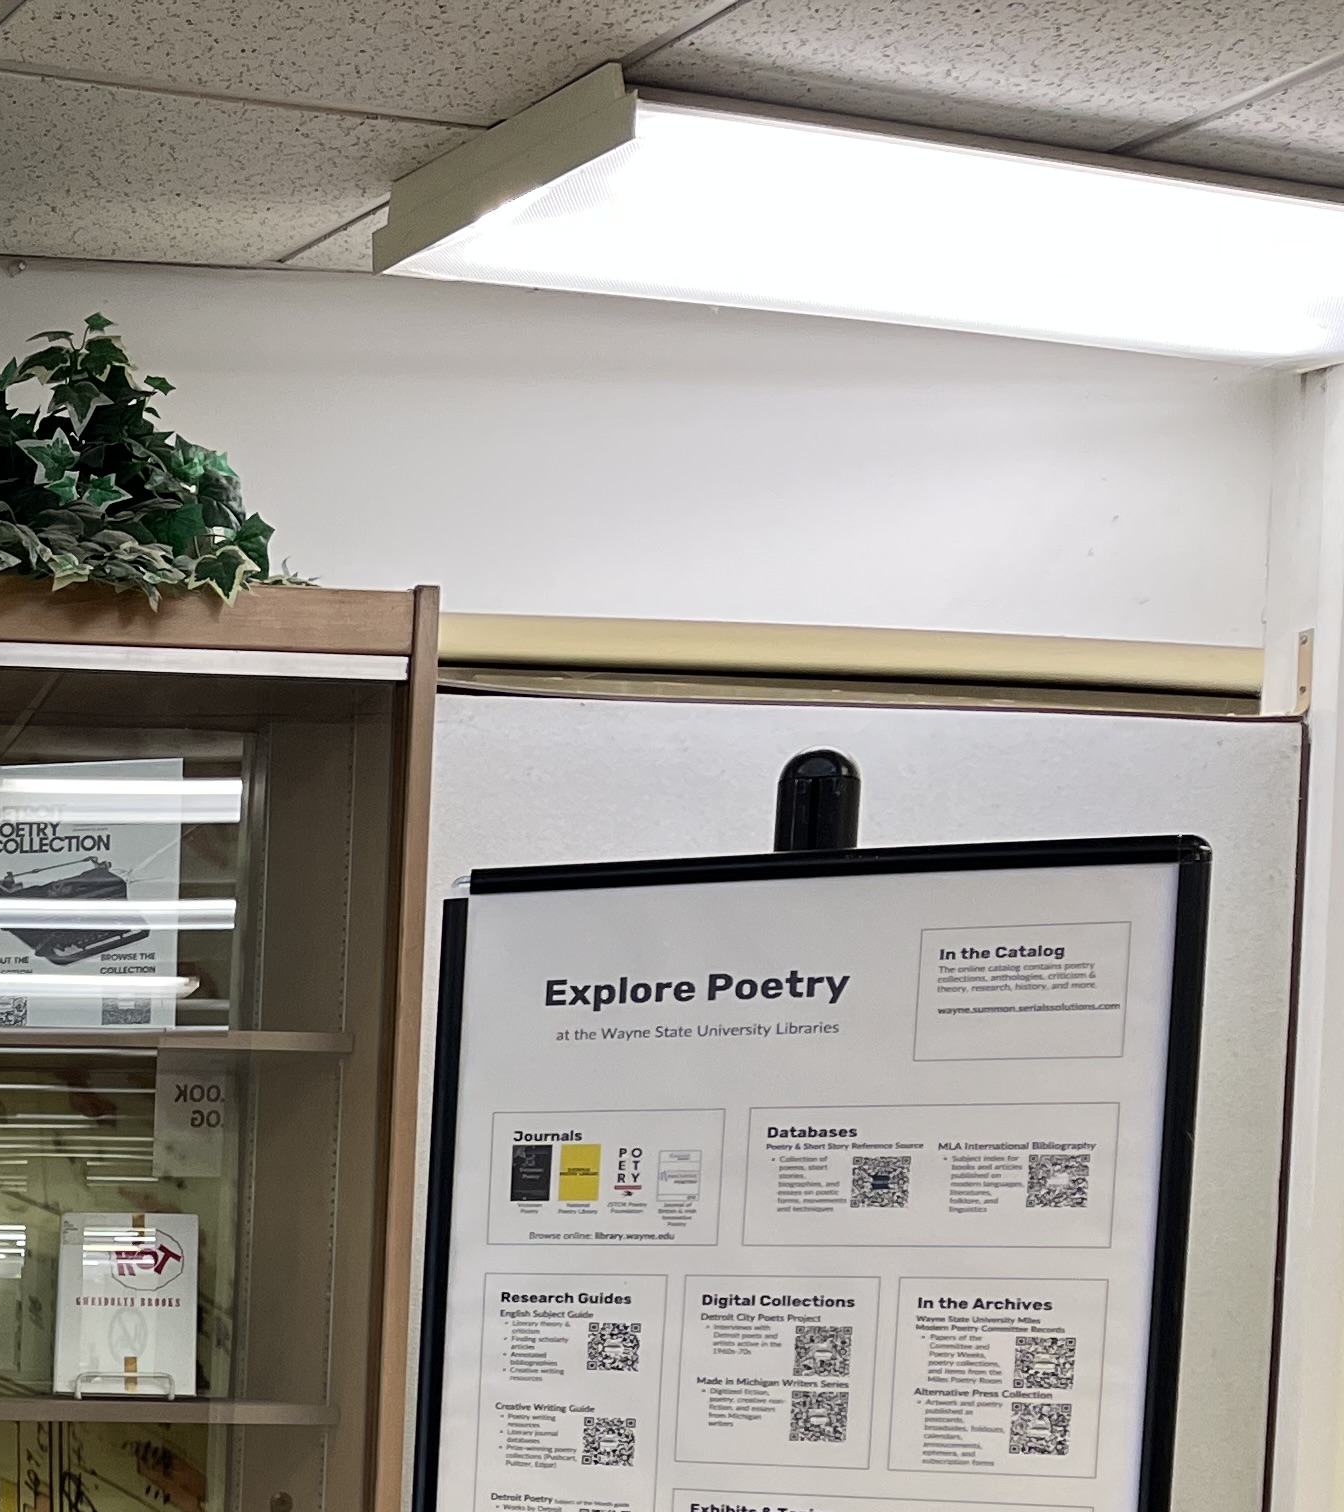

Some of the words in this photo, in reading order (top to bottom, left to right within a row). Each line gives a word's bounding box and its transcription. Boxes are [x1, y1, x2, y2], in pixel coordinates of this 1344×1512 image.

[100, 953, 139, 962] BROWSE
[140, 952, 156, 961] THE
[941, 949, 956, 960] In
[961, 947, 991, 960] the
[995, 945, 1065, 959] Catalog
[12, 956, 30, 965] THE
[99, 965, 156, 975] COLLECTION
[545, 977, 696, 1012] Explore
[707, 970, 850, 1004] Poetry
[556, 1030, 570, 1041] at
[575, 1029, 597, 1041] the
[601, 1027, 651, 1040] Wayne
[655, 1025, 693, 1038] State
[697, 1024, 771, 1037] University
[776, 1022, 840, 1035] Libraries
[513, 1130, 582, 1142] Journals
[767, 1126, 858, 1138] Databases
[939, 1143, 963, 1151] MLA
[964, 1143, 1030, 1151] International
[1032, 1142, 1097, 1151] Bibliography
[140, 1298, 181, 1307] BROOKS
[502, 1292, 574, 1304] Research
[578, 1293, 632, 1305] Guides
[703, 1294, 756, 1308] Digital
[760, 1295, 855, 1308] Collections
[919, 1297, 934, 1309] In
[939, 1298, 968, 1309] the
[973, 1298, 1053, 1311] Archives
[501, 1310, 531, 1319] English
[533, 1310, 566, 1318] Subject
[567, 1311, 594, 1319] Guide
[701, 1313, 734, 1321] Detroit
[736, 1313, 755, 1323] City
[757, 1314, 785, 1322] Poets
[787, 1314, 822, 1323] Project
[697, 1377, 723, 1385] Made
[736, 1378, 780, 1388] Michigan
[782, 1380, 819, 1388] Writers
[820, 1380, 850, 1389] Series
[915, 1388, 970, 1397] Alternative
[971, 1389, 999, 1398] Press
[1001, 1390, 1053, 1400] Collection
[496, 1402, 531, 1411] Creative
[533, 1404, 567, 1413] Writing
[569, 1405, 596, 1413] Guide
[492, 1493, 522, 1502] Detroit
[524, 1495, 555, 1504] Poetry
